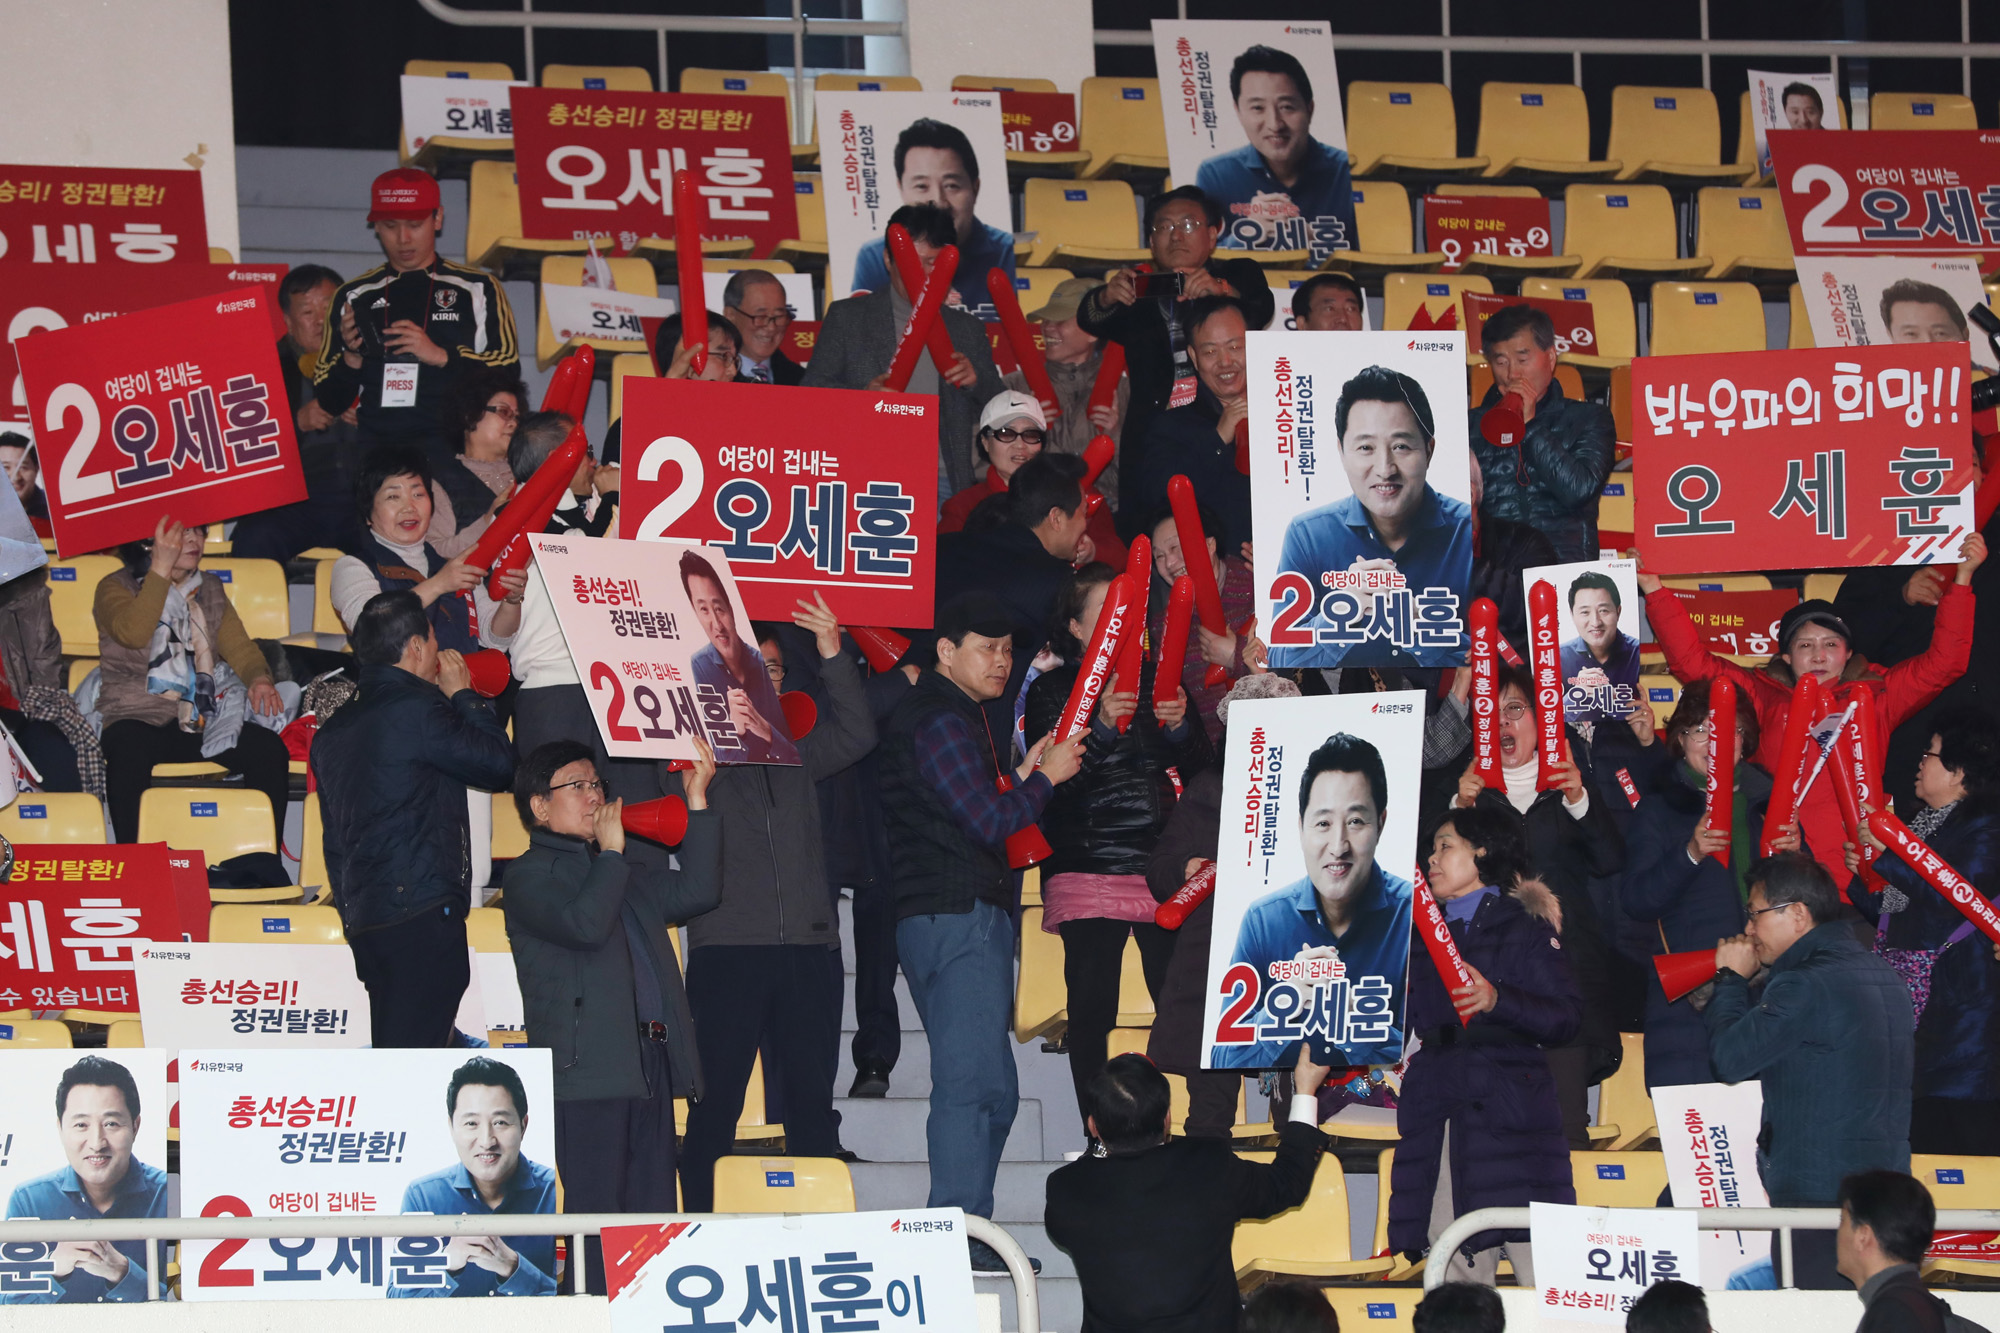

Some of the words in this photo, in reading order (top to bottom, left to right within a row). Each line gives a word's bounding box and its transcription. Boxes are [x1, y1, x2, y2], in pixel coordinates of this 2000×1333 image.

[1176, 36, 1199, 136] 총선승리!
[1194, 50, 1218, 149] 정권탈환!
[547, 103, 648, 129] 총선승리!
[654, 108, 754, 132] 정권탈환!
[839, 109, 861, 216] 총선승리!
[858, 124, 880, 231] 정권탈환!
[1856, 167, 1906, 186] 여당이
[1910, 167, 1960, 186] 겁내는
[61, 182, 167, 208] 정권탈환!
[541, 145, 774, 222] 오세훈
[1791, 164, 1861, 243] 2
[222, 298, 257, 314] 자유한국당
[431, 312, 460, 322] KIRIN
[1415, 342, 1454, 352] 자유한국당
[105, 371, 153, 402] 여당이
[156, 361, 203, 392] 겁내는
[386, 379, 414, 391] PRESS
[882, 403, 925, 417] 자유한국당
[1644, 377, 1821, 438] 보수우파의
[1831, 361, 1961, 429] 희망!!
[1273, 356, 1295, 484] 총선승리!
[45, 382, 116, 506] 2
[111, 373, 280, 490] 오세훈
[1295, 374, 1316, 502] 정권탈환!
[718, 446, 775, 474] 여당이
[782, 448, 840, 477] 겁내는
[636, 435, 704, 546] 2
[705, 477, 918, 577] 오세훈
[572, 574, 643, 608] 총선승리!
[1321, 570, 1362, 588] 여당이
[1366, 570, 1407, 588] 겁내는
[609, 609, 681, 641] 정권탈환!
[1268, 569, 1316, 648] 2
[1316, 586, 1464, 649] 오세훈
[1709, 614, 1745, 627] 겁내는
[1093, 617, 1123, 676] 오세훈
[1536, 630, 1557, 687] 오세훈
[621, 660, 652, 680] 여당이
[653, 662, 683, 683] 겁내는
[1473, 640, 1492, 695] 오세훈
[590, 660, 642, 742] 2
[632, 683, 742, 751] 오세훈
[1378, 703, 1414, 715] 자유한국당
[1566, 683, 1636, 713] 오세훈
[1478, 717, 1493, 770] 정권탈환
[1543, 710, 1560, 766] 정권탈환
[1243, 726, 1267, 867] 총선승리!
[1260, 745, 1284, 885] 정권탈환!
[9, 859, 125, 882] 정권탈환!
[1907, 841, 1958, 889] 오세훈
[150, 951, 191, 961] 자유한국당
[1268, 959, 1305, 982] 여당이
[1309, 958, 1346, 980] 겁내는
[31, 986, 130, 1007] 있습니다
[180, 978, 299, 1006] 총선승리!
[1213, 961, 1261, 1045] 2
[1258, 975, 1394, 1045] 오세훈
[230, 1008, 349, 1035] 정권탈환!
[199, 1061, 244, 1073] 자유한국당
[227, 1094, 357, 1129] 총선승리!
[278, 1131, 407, 1164] 정권탈환!
[268, 1191, 319, 1213] 여당이
[326, 1191, 377, 1213] 겁내는
[197, 1194, 255, 1288] 2
[262, 1212, 452, 1289] 오세훈
[901, 1219, 954, 1234] 자유한국당
[1586, 1232, 1613, 1246] 여당이
[1617, 1233, 1643, 1248] 겁내는
[1585, 1248, 1681, 1287] 오세훈
[662, 1251, 926, 1333] 오세훈이
[1544, 1287, 1616, 1312] 총선승리!
